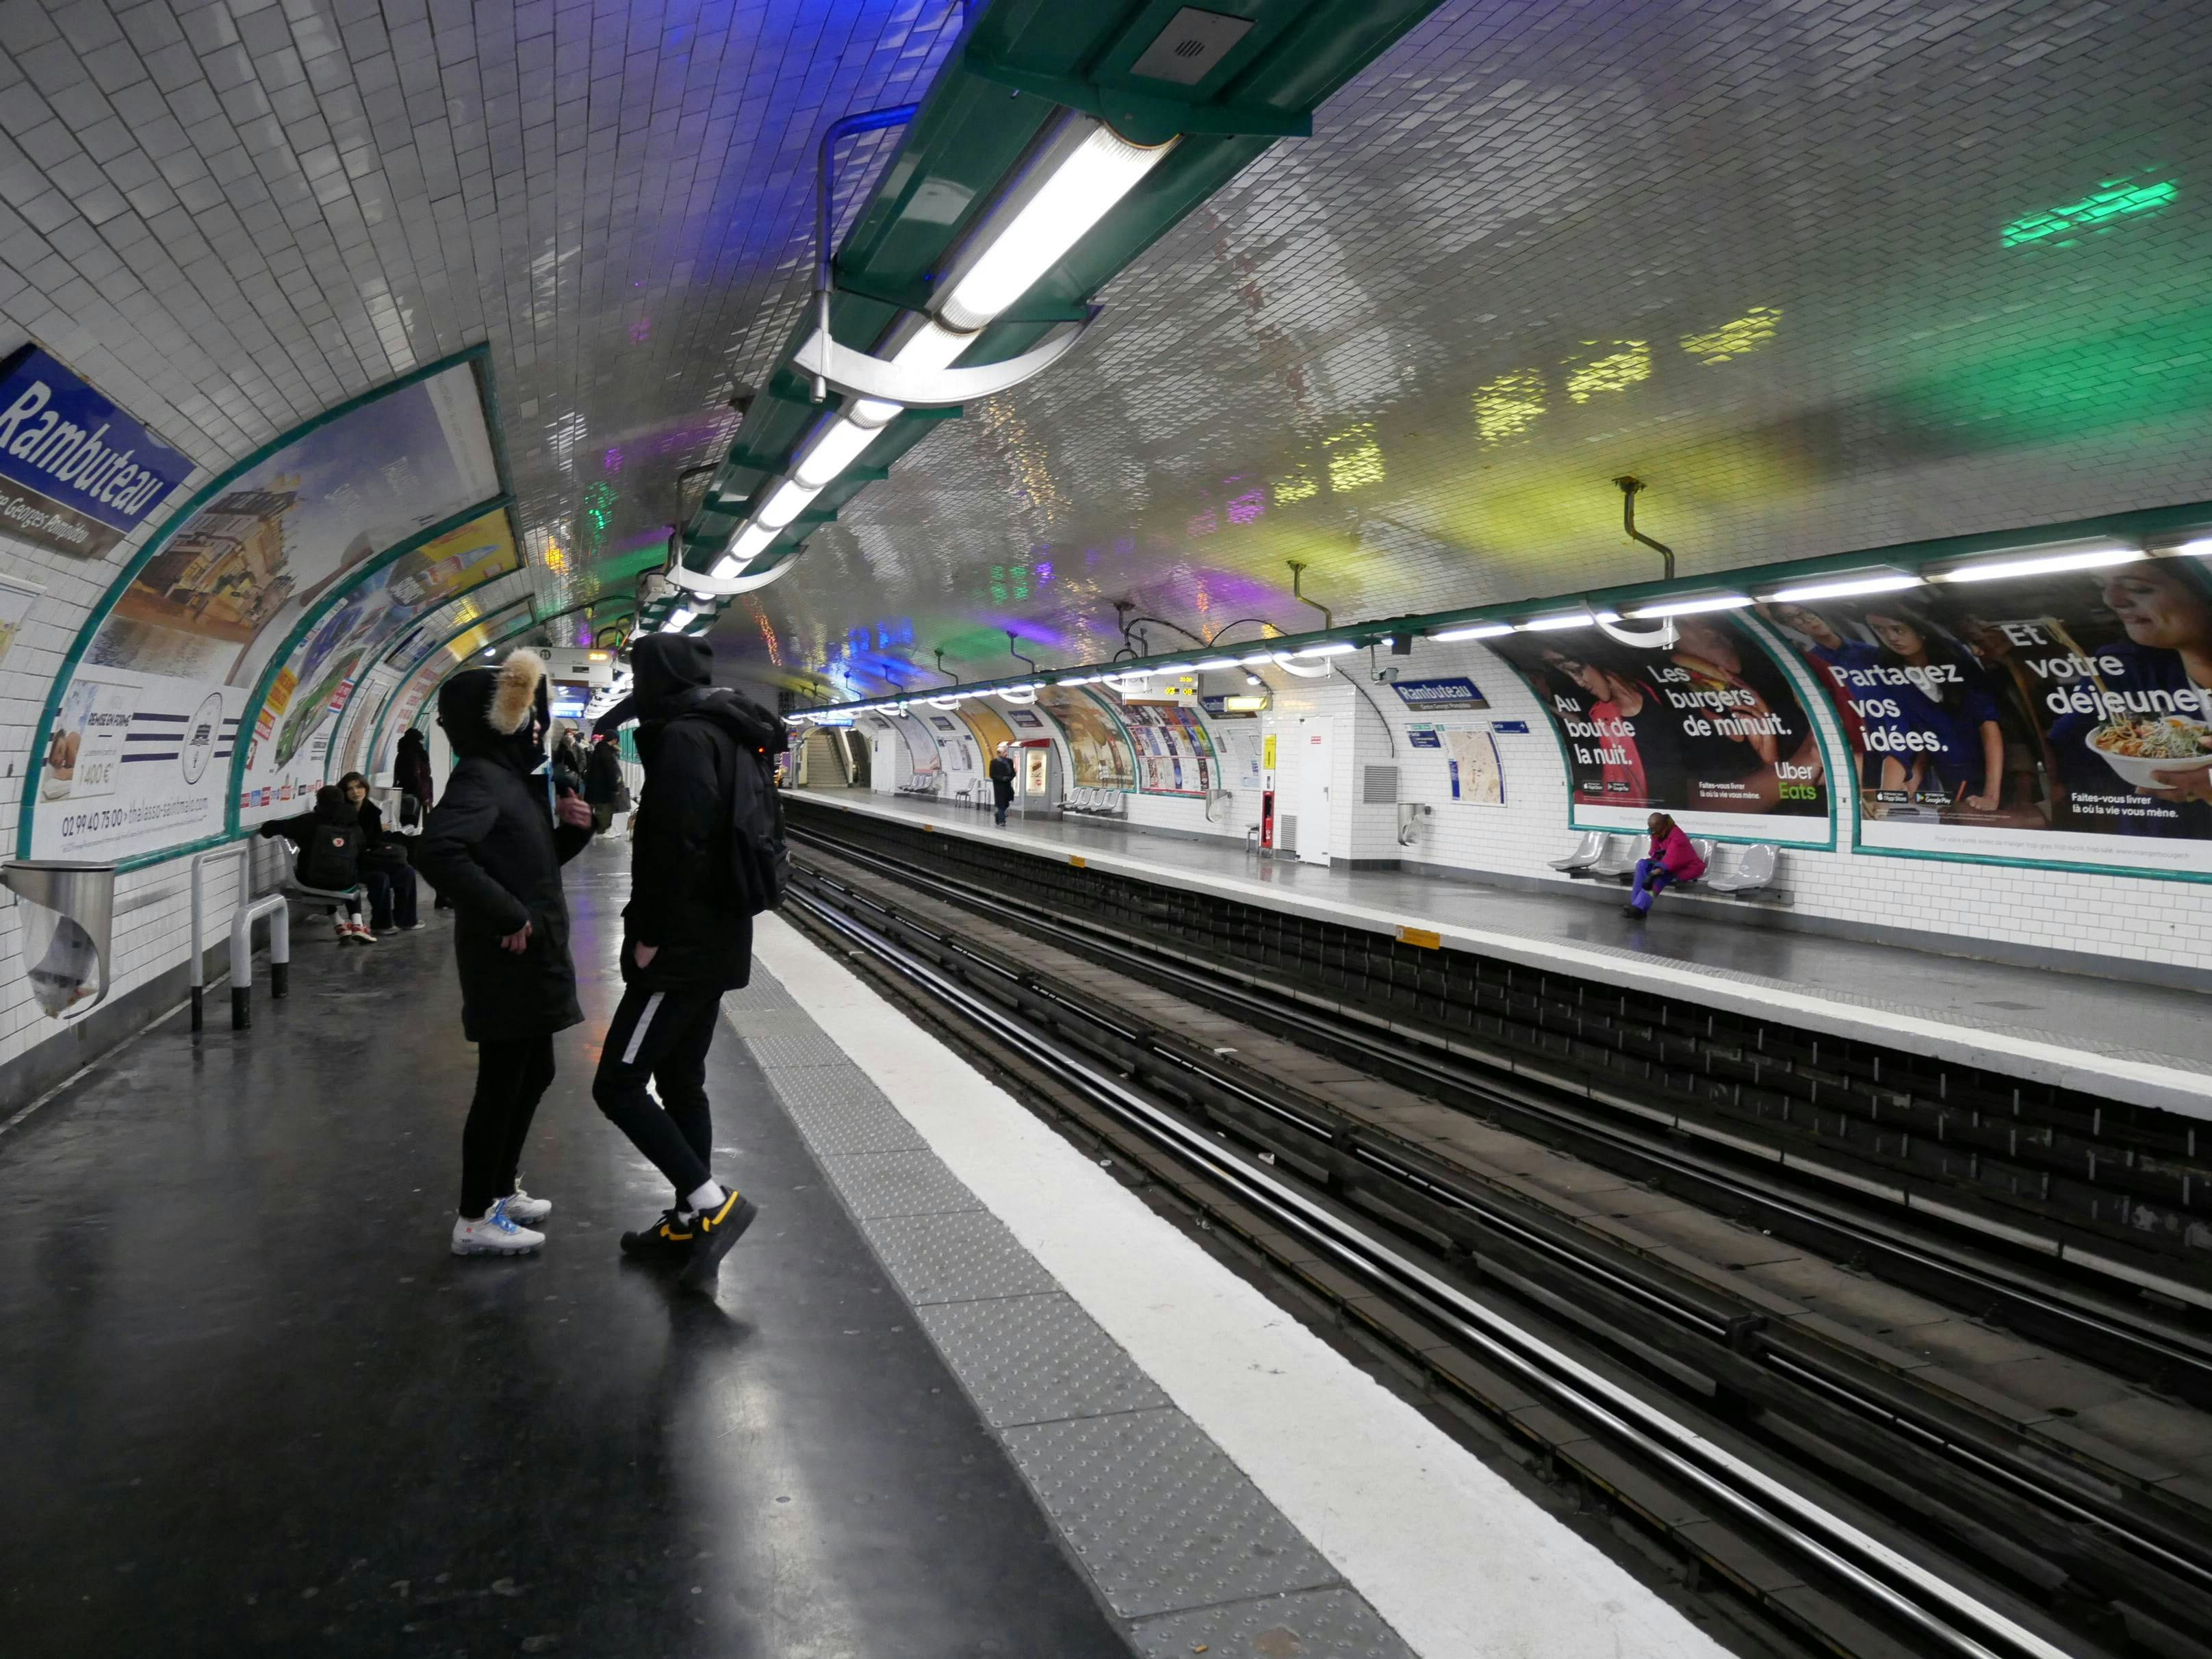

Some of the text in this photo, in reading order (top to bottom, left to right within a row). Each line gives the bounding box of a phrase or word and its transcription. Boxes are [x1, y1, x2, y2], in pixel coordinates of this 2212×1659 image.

[0, 381, 164, 516] Rambuteau
[4, 498, 49, 528] Georges
[2001, 623, 2048, 646] Et
[1647, 665, 1690, 683] Les
[2025, 653, 2125, 678] votre
[1828, 665, 1964, 690] Partagez
[1398, 684, 1473, 699] Rambuteau
[1665, 689, 1756, 712] burgers
[1554, 694, 1581, 712] Au
[1848, 699, 1901, 718] vos
[1564, 717, 1636, 737] bout de
[1683, 712, 1792, 736] de minuit.
[1860, 725, 1949, 751] idées.
[1574, 744, 1632, 764] la nuit.
[1775, 761, 1812, 779] Uber
[1779, 782, 1816, 799] Eats
[2071, 793, 2152, 805] Faites-vous livrer
[2072, 804, 2081, 813] là
[2082, 805, 2094, 814] où
[2096, 806, 2105, 814] la
[2105, 806, 2120, 815] vie
[2146, 808, 2179, 818] mène.
[62, 816, 74, 836] 02
